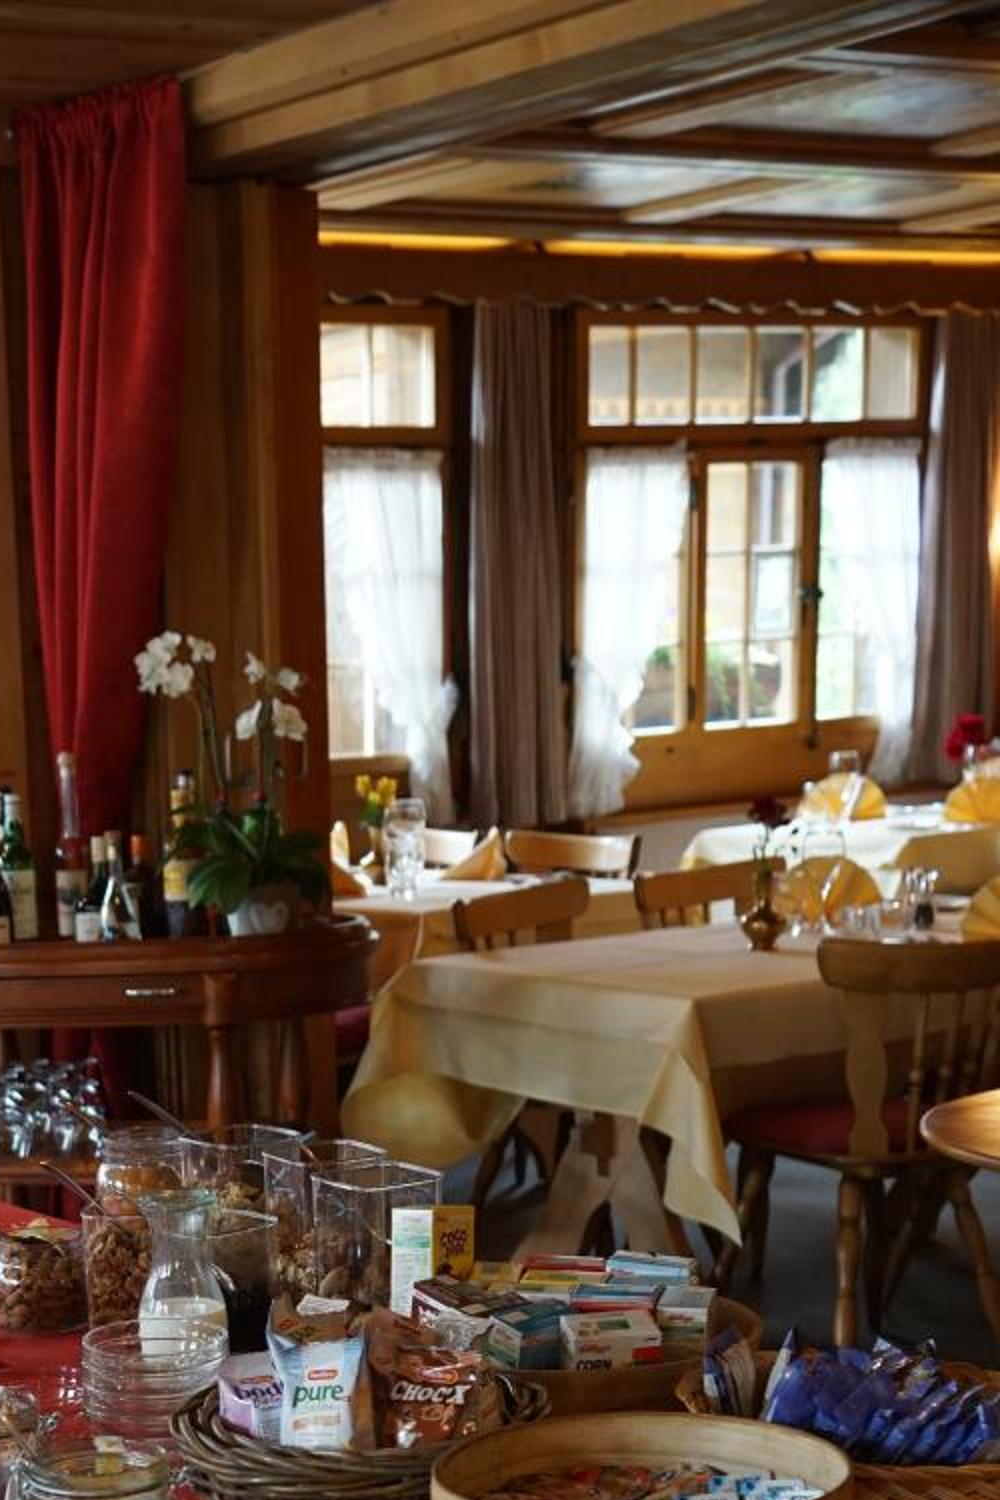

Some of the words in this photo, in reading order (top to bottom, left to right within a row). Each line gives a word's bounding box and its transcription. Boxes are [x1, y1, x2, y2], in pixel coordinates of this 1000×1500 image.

[576, 1359, 612, 1371] CORN
[231, 1380, 284, 1400] bod
[292, 1384, 343, 1408] pure
